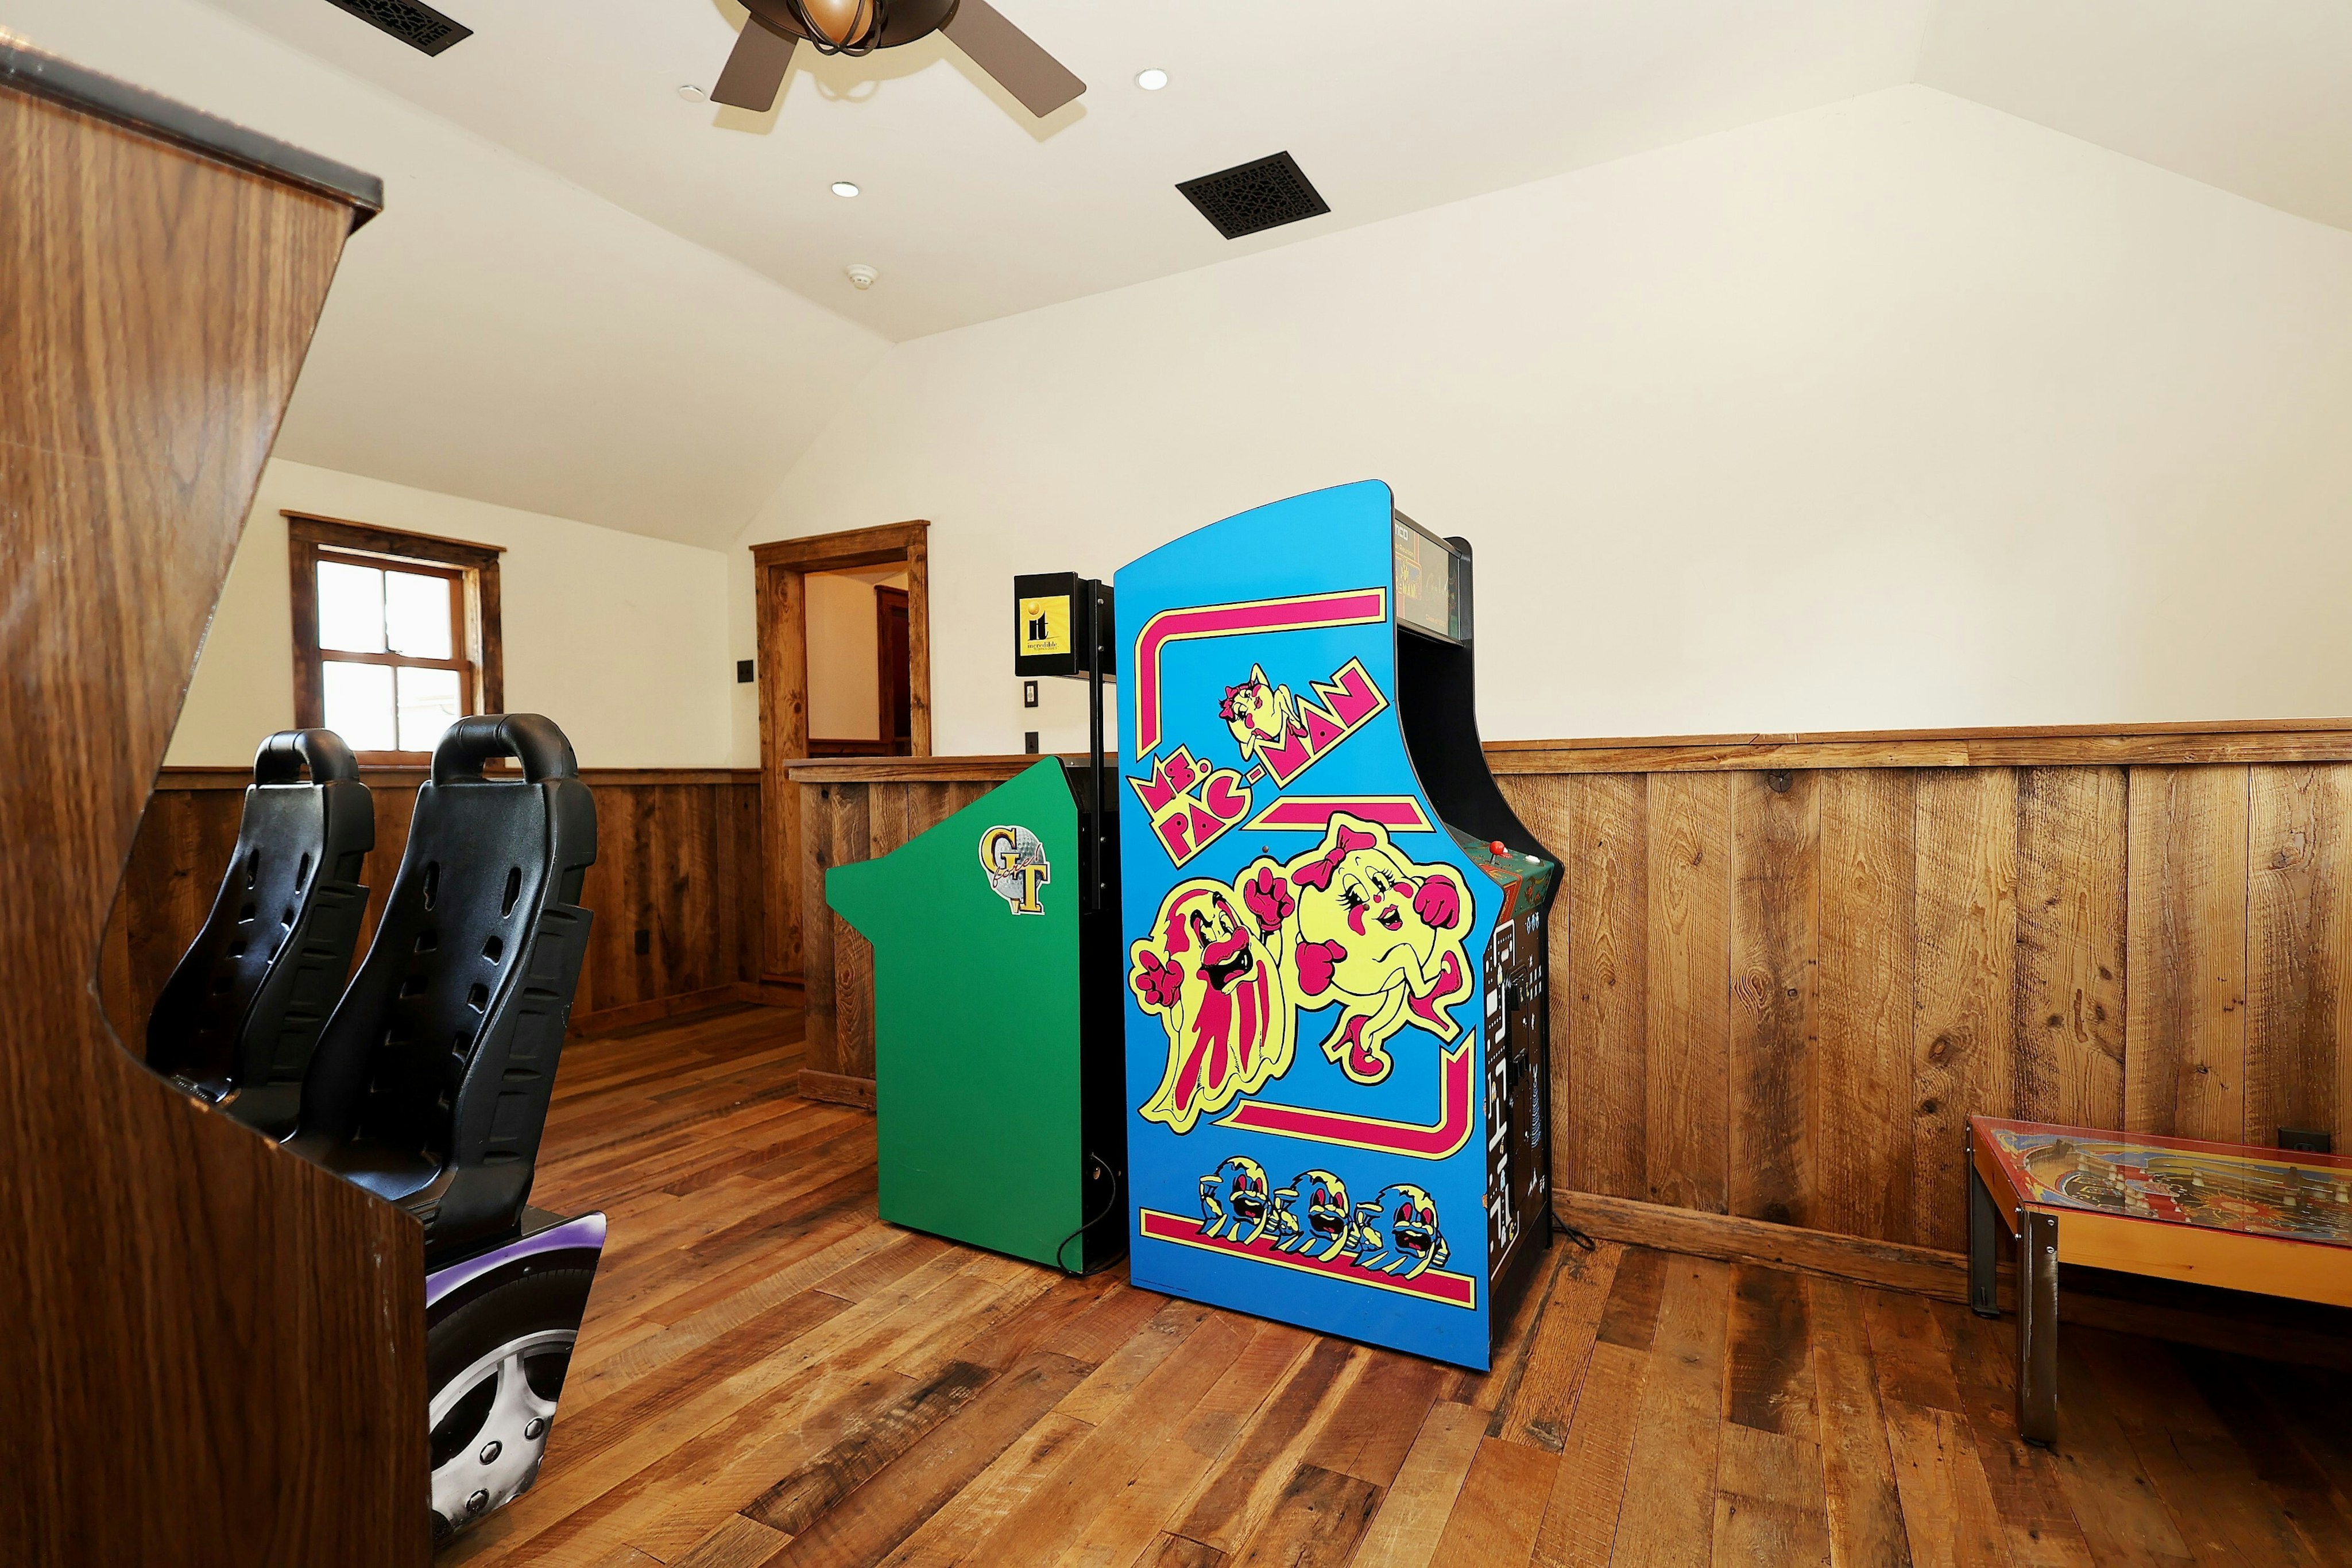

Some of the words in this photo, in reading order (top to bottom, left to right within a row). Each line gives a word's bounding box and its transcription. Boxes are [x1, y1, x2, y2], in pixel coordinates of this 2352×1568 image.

[1027, 601, 1049, 641] it
[1027, 641, 1057, 649] incredible
[981, 827, 1048, 912] GT
